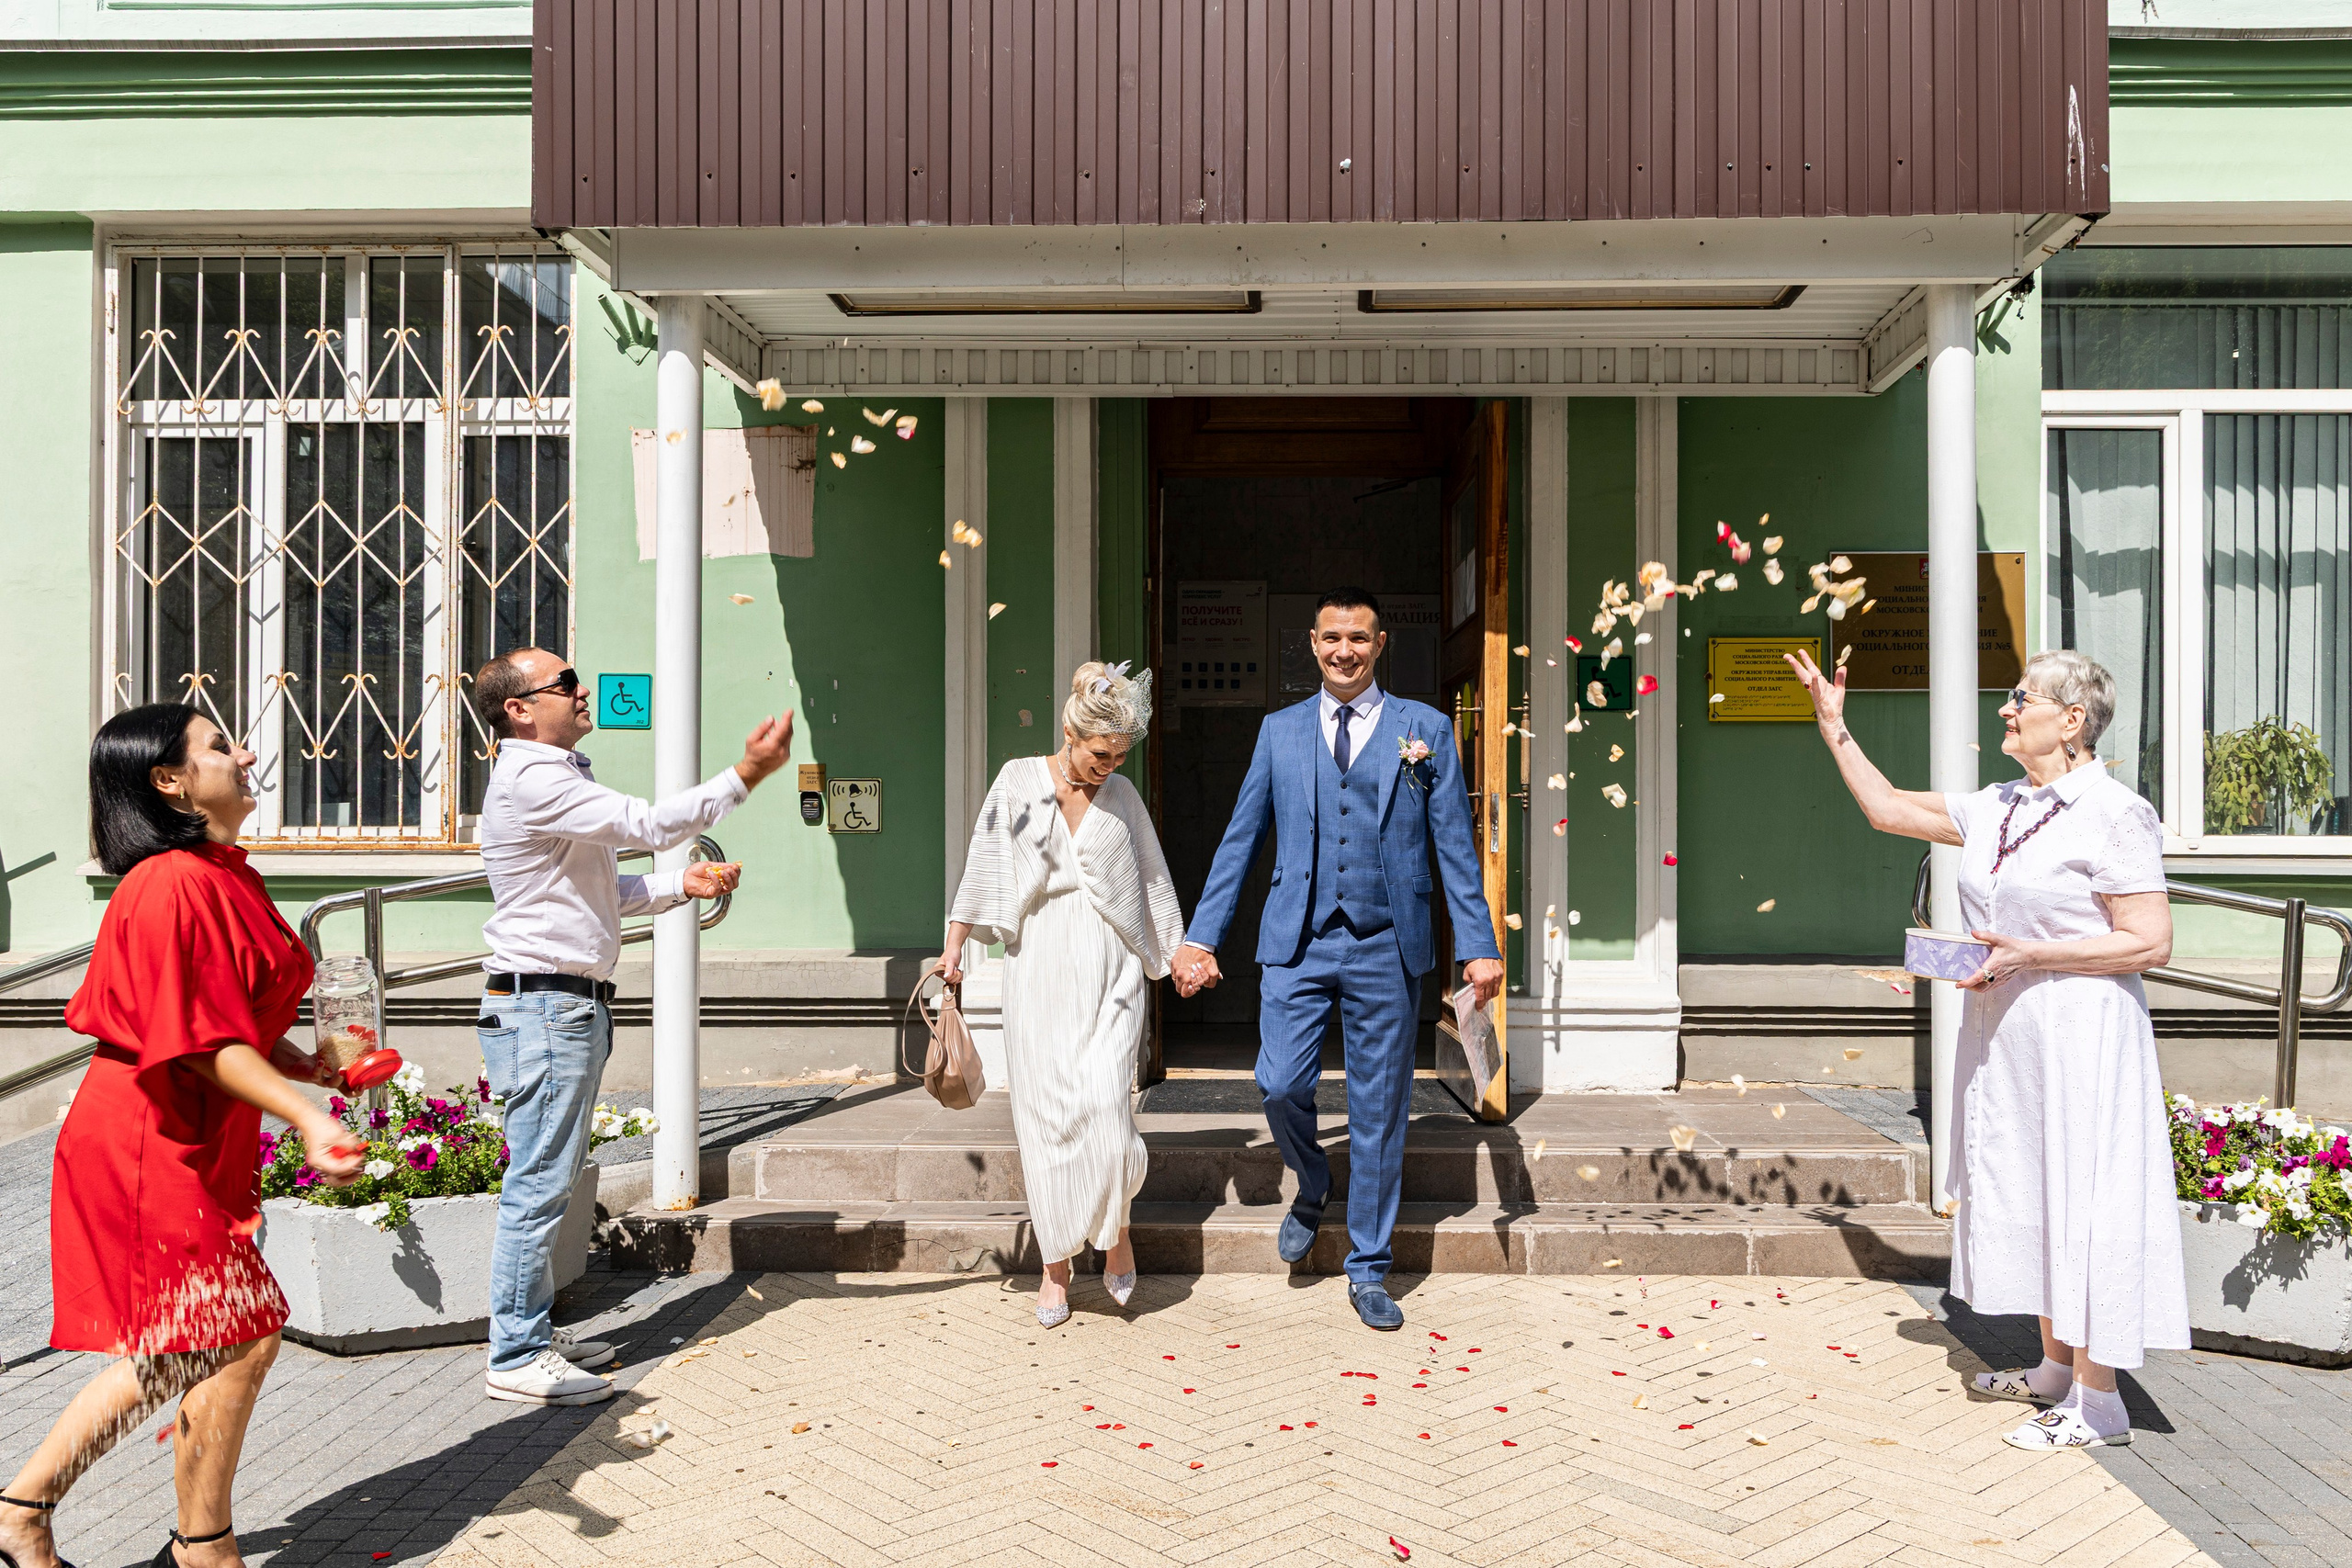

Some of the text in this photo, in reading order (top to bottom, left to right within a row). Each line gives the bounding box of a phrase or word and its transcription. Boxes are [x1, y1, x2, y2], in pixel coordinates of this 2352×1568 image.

[1182, 605, 1242, 615] ПОЛУЧИТЕ
[1182, 616, 1198, 626] ВСЁ
[1861, 629, 1925, 637] ОКРУЖНОЕ
[1994, 642, 2011, 650] №5
[1892, 665, 1929, 675] ОТДЕ
